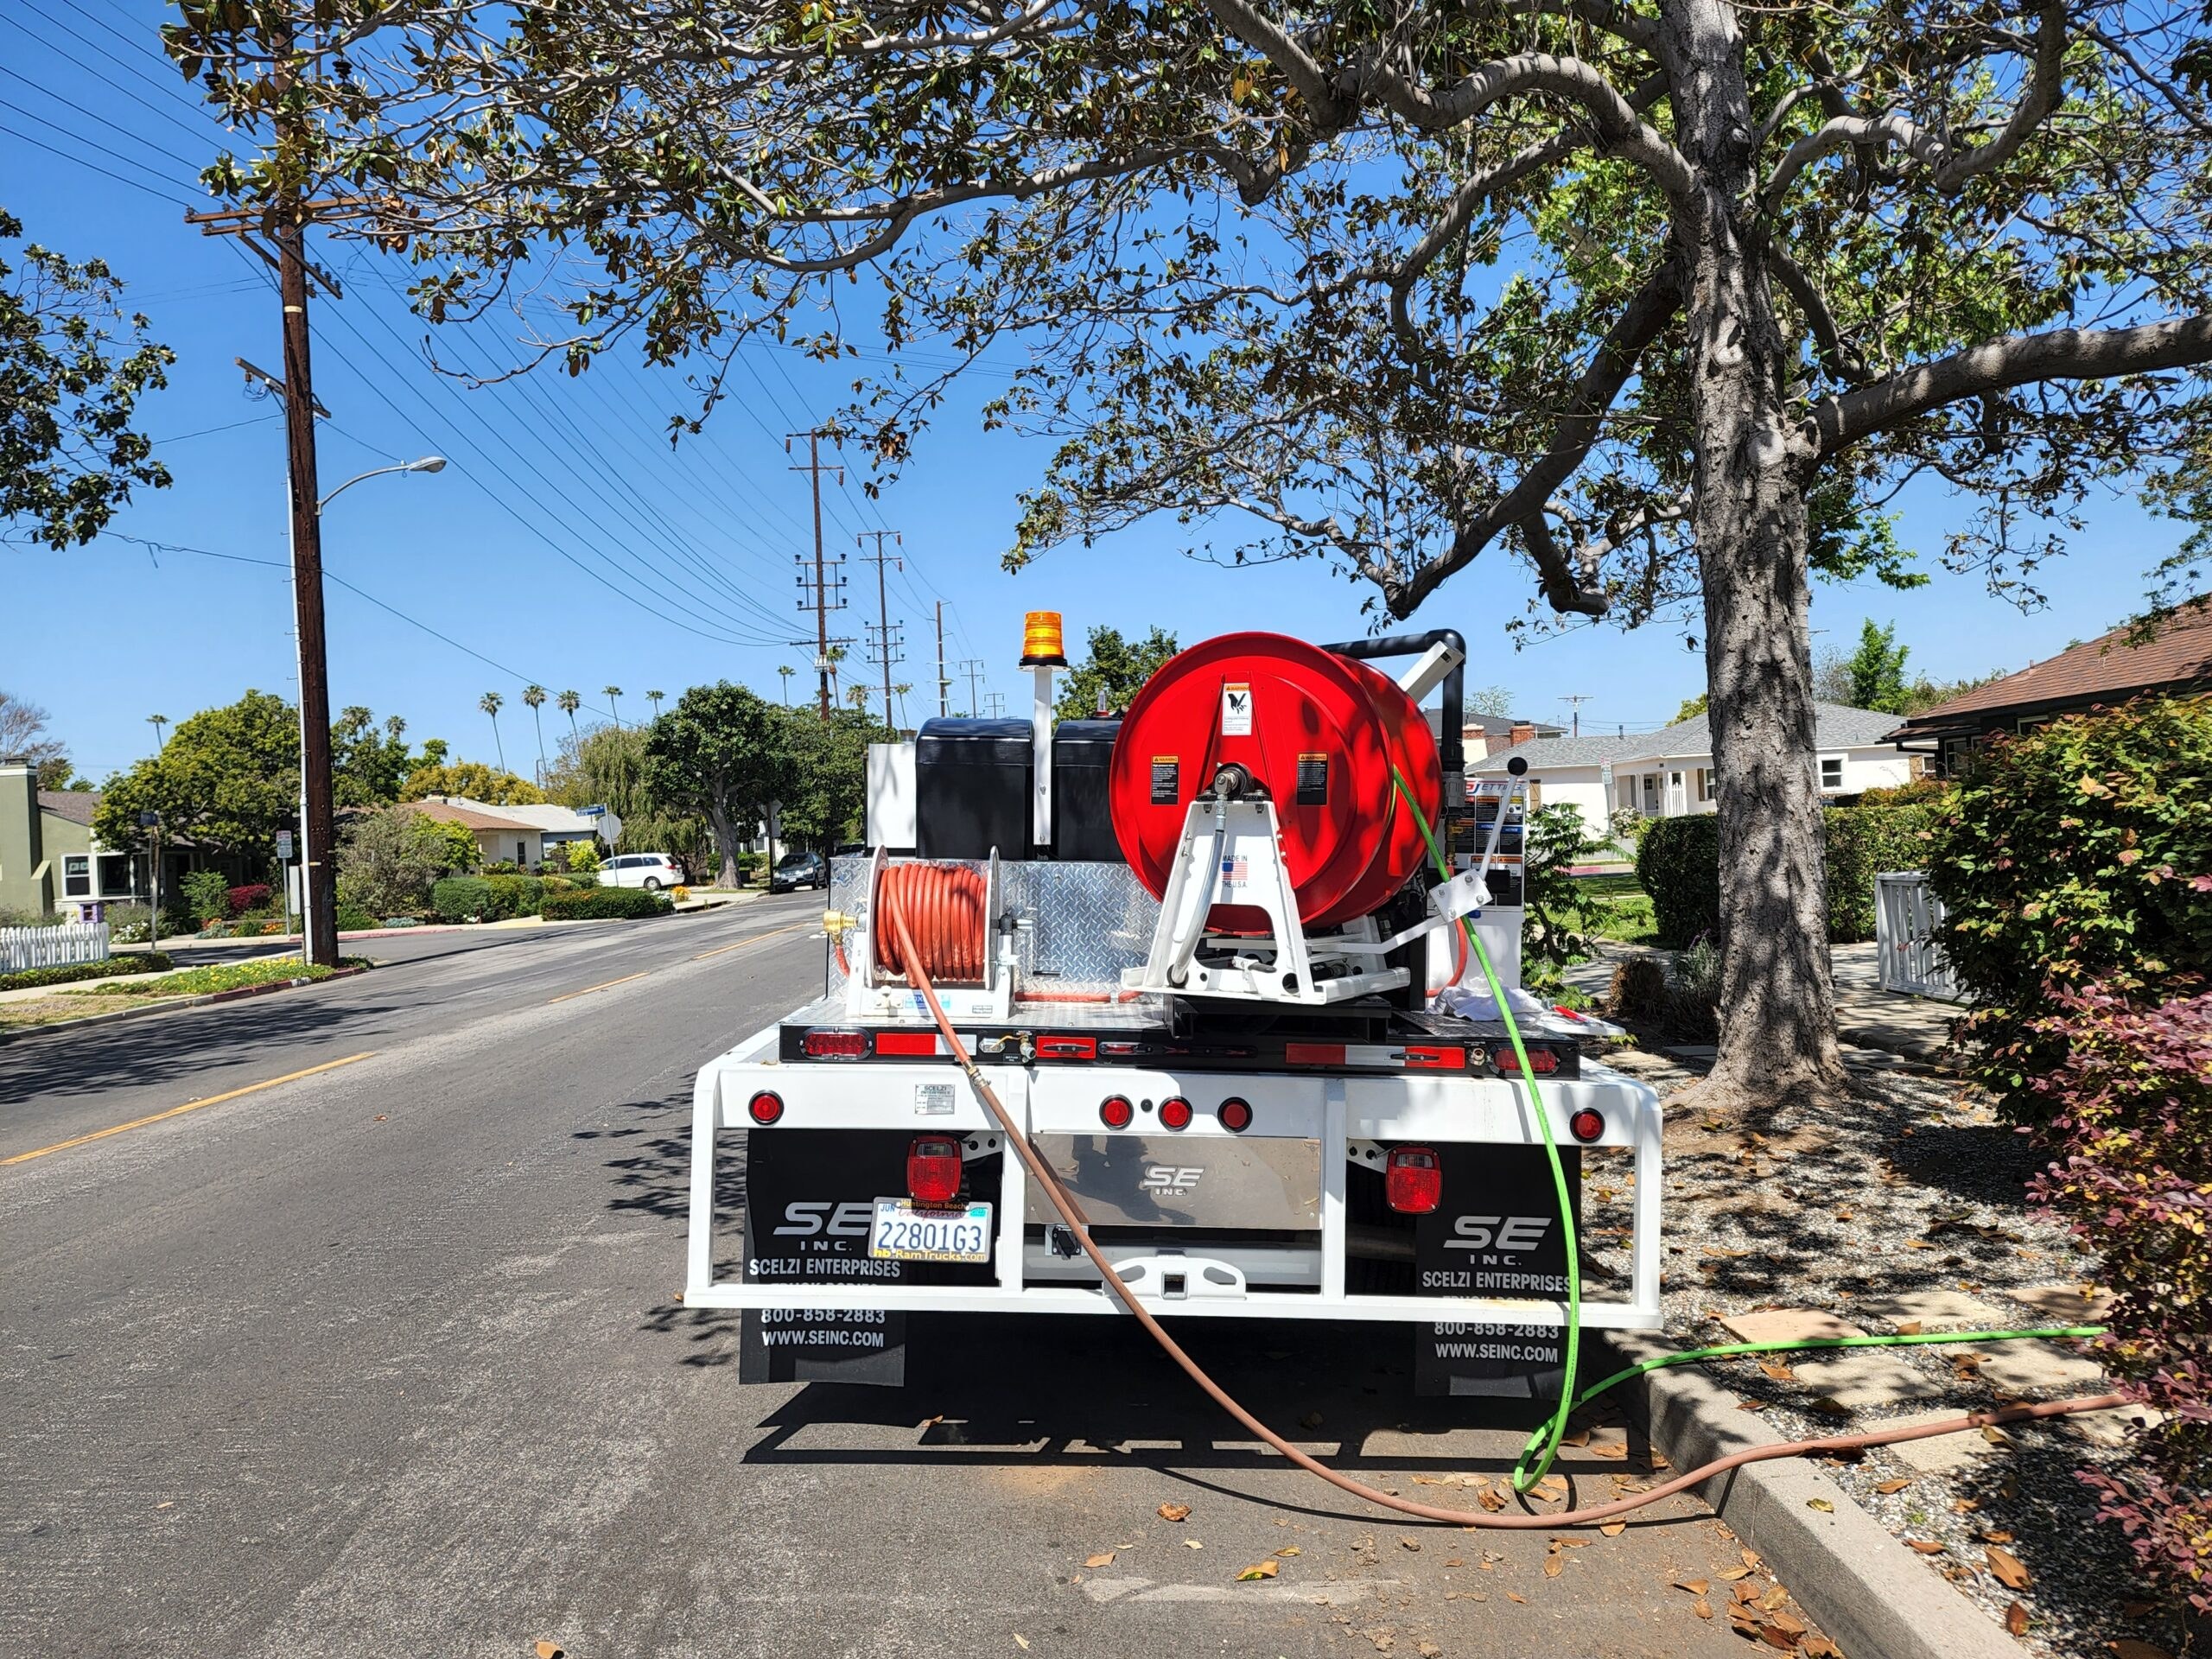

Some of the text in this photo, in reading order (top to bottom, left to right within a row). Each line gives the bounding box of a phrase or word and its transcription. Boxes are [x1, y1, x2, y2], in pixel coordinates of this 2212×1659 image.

[1144, 1167, 1205, 1186] SE
[900, 1199, 942, 1210] Huntington
[772, 1202, 874, 1236] SE
[899, 1209, 963, 1221] California
[878, 1221, 982, 1252] 22801G3
[1443, 1216, 1552, 1250] SE
[800, 1241, 853, 1251] INC.
[749, 1258, 900, 1278] SCELZI ENTERPRISES
[1470, 1255, 1522, 1265] INC.
[1422, 1271, 1571, 1293] SCELZI ENTERPRISES
[760, 1308, 886, 1324] 800-858-2883
[762, 1330, 884, 1347] WWW.SEINC.COM
[1434, 1322, 1559, 1339] 800-858-2883
[1435, 1343, 1558, 1363] WWW.SEINC.COM
